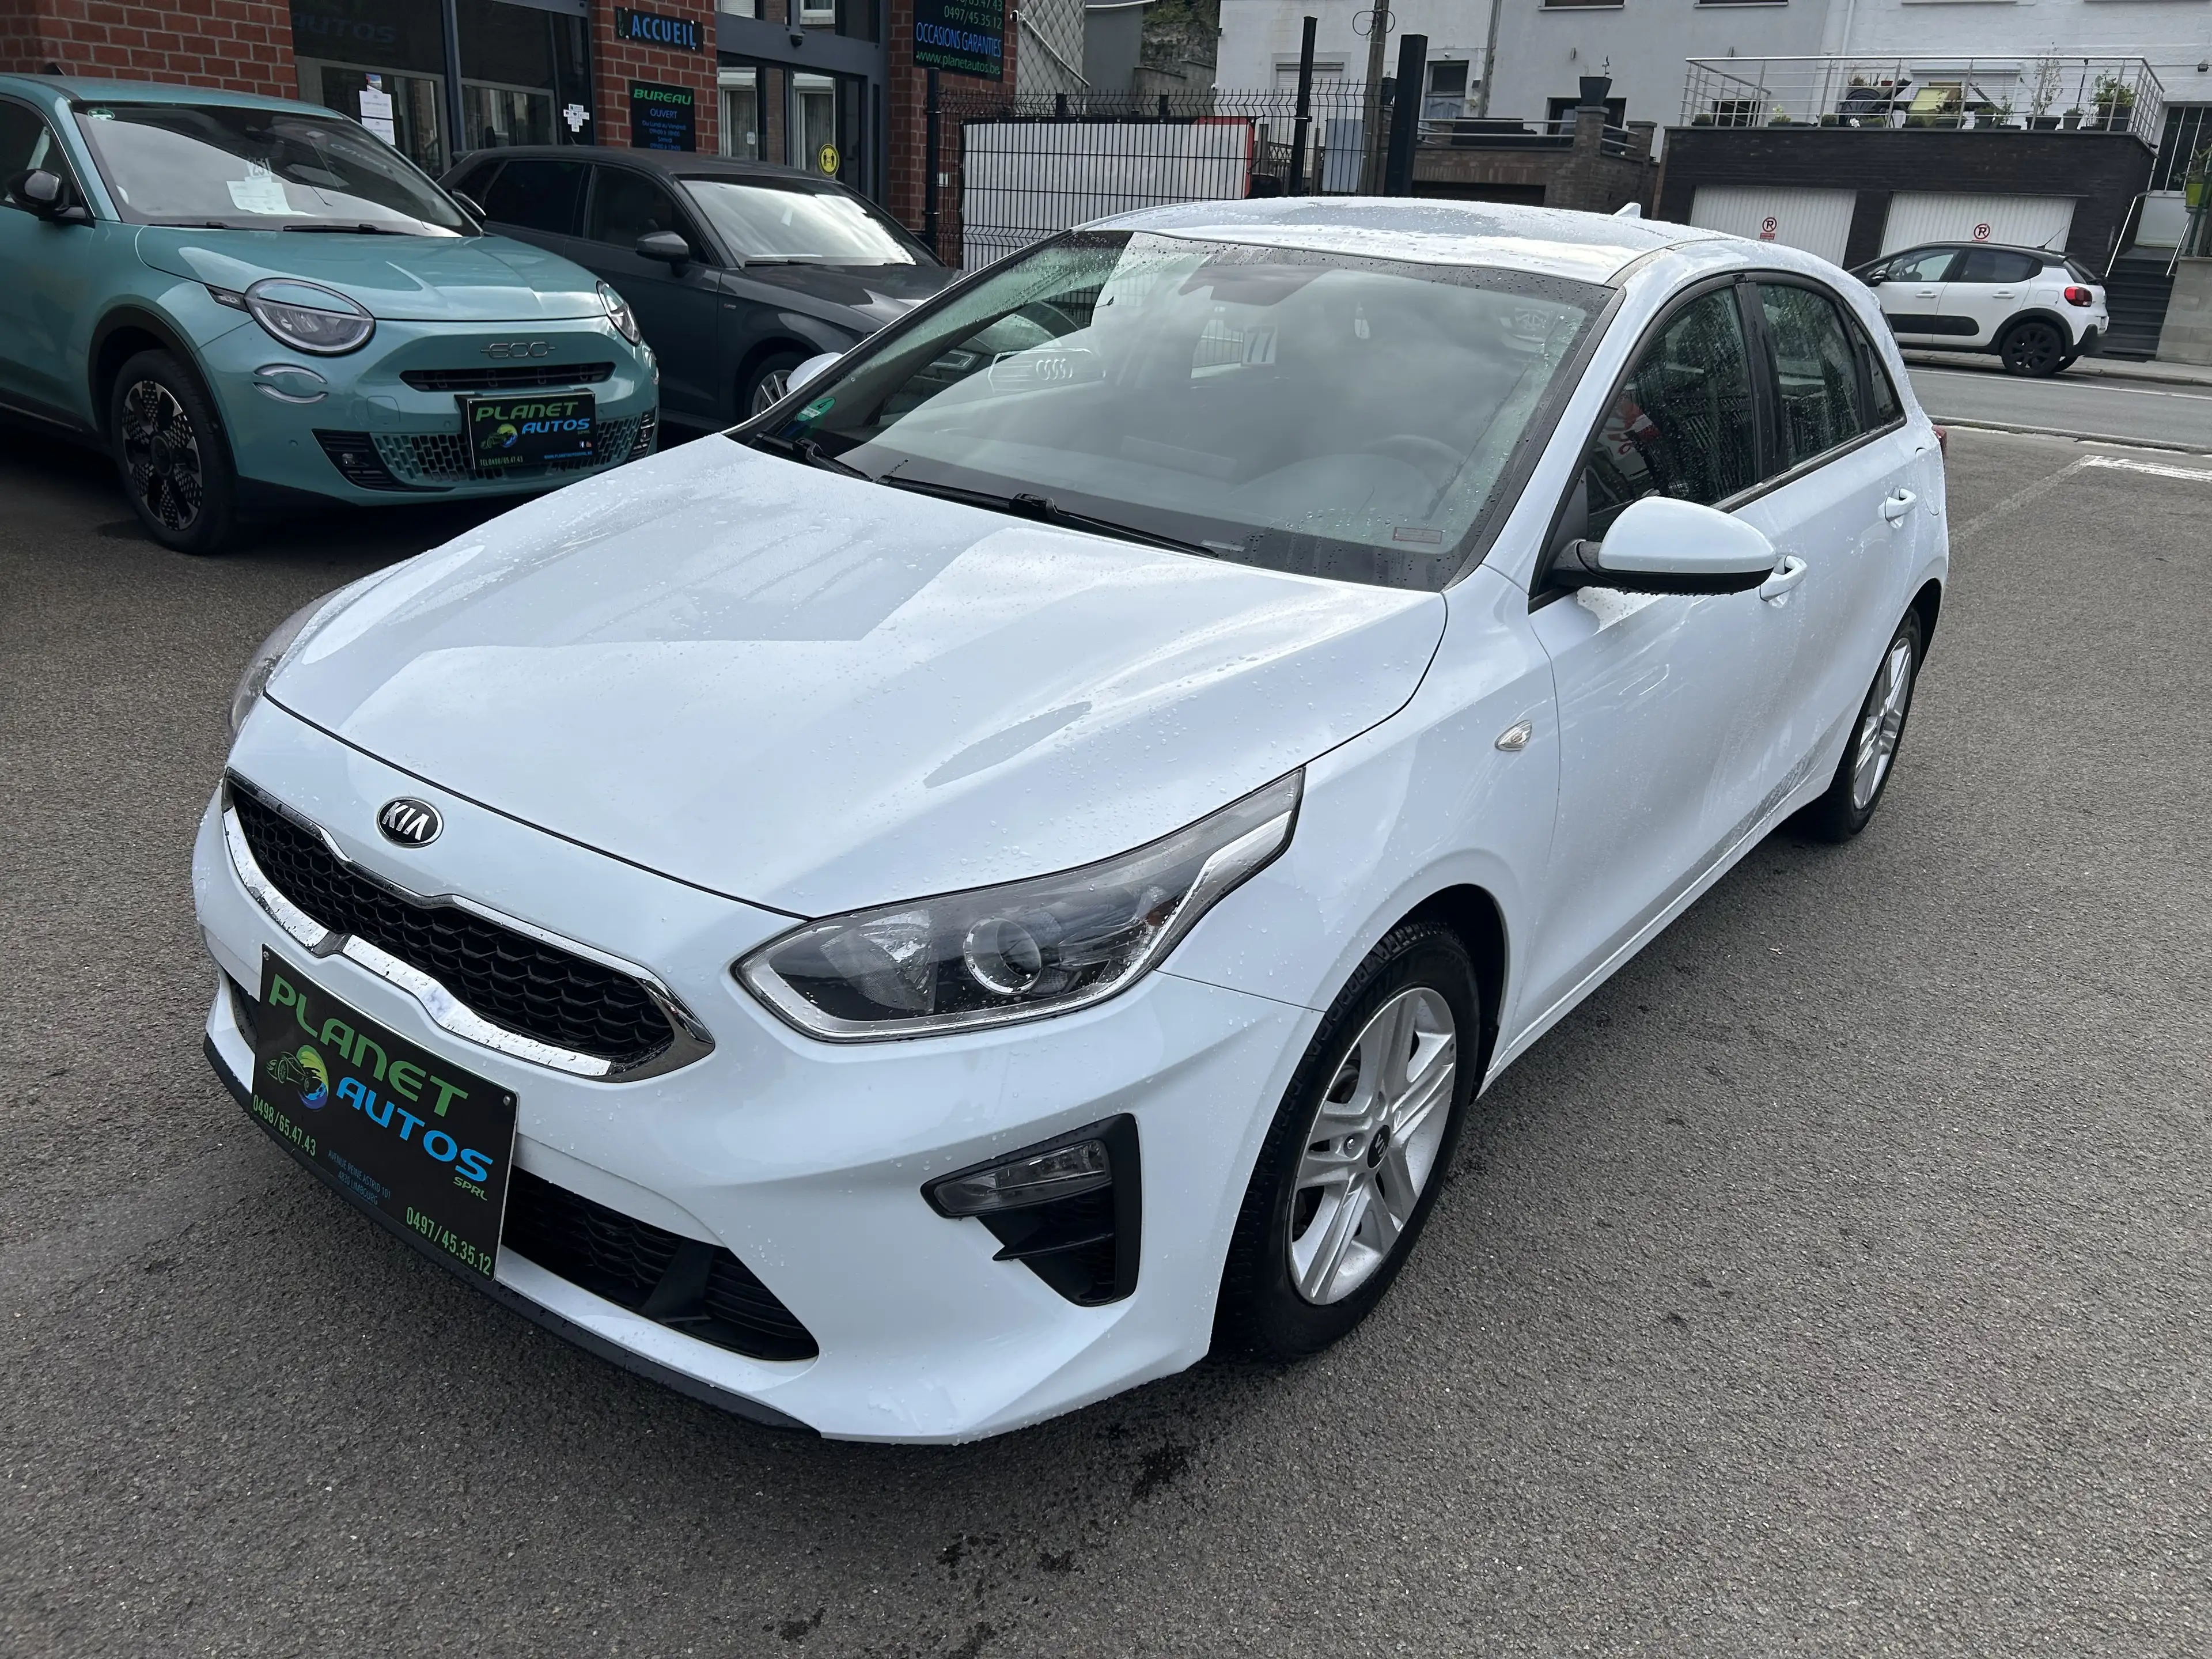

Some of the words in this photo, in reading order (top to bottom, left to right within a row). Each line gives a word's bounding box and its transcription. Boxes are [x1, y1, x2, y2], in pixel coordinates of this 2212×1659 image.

[632, 15, 696, 47] ACCUEIL
[944, 5, 1002, 29] 0497/45.35.12
[916, 22, 961, 50] OCCASIONS
[961, 32, 1002, 58] GARANTIES
[916, 51, 1001, 75] www.planetautos.be
[634, 88, 691, 105] BUREAU
[650, 108, 677, 119] OUVERT
[475, 402, 579, 422] PLANET
[521, 418, 590, 435] AUTOS
[382, 801, 430, 840] KIA
[268, 973, 468, 1118] PLANET
[252, 1094, 316, 1156] 0498/65.47.43
[336, 1077, 493, 1183] AUTOS
[328, 1149, 347, 1170] AVENUE
[347, 1162, 362, 1181] REINE
[362, 1173, 381, 1193] ASTRID
[381, 1186, 391, 1200] 101
[452, 1176, 488, 1201] SPRL
[350, 1179, 378, 1206] LIMBOURG
[406, 1206, 492, 1276] 0497/45.35.12
